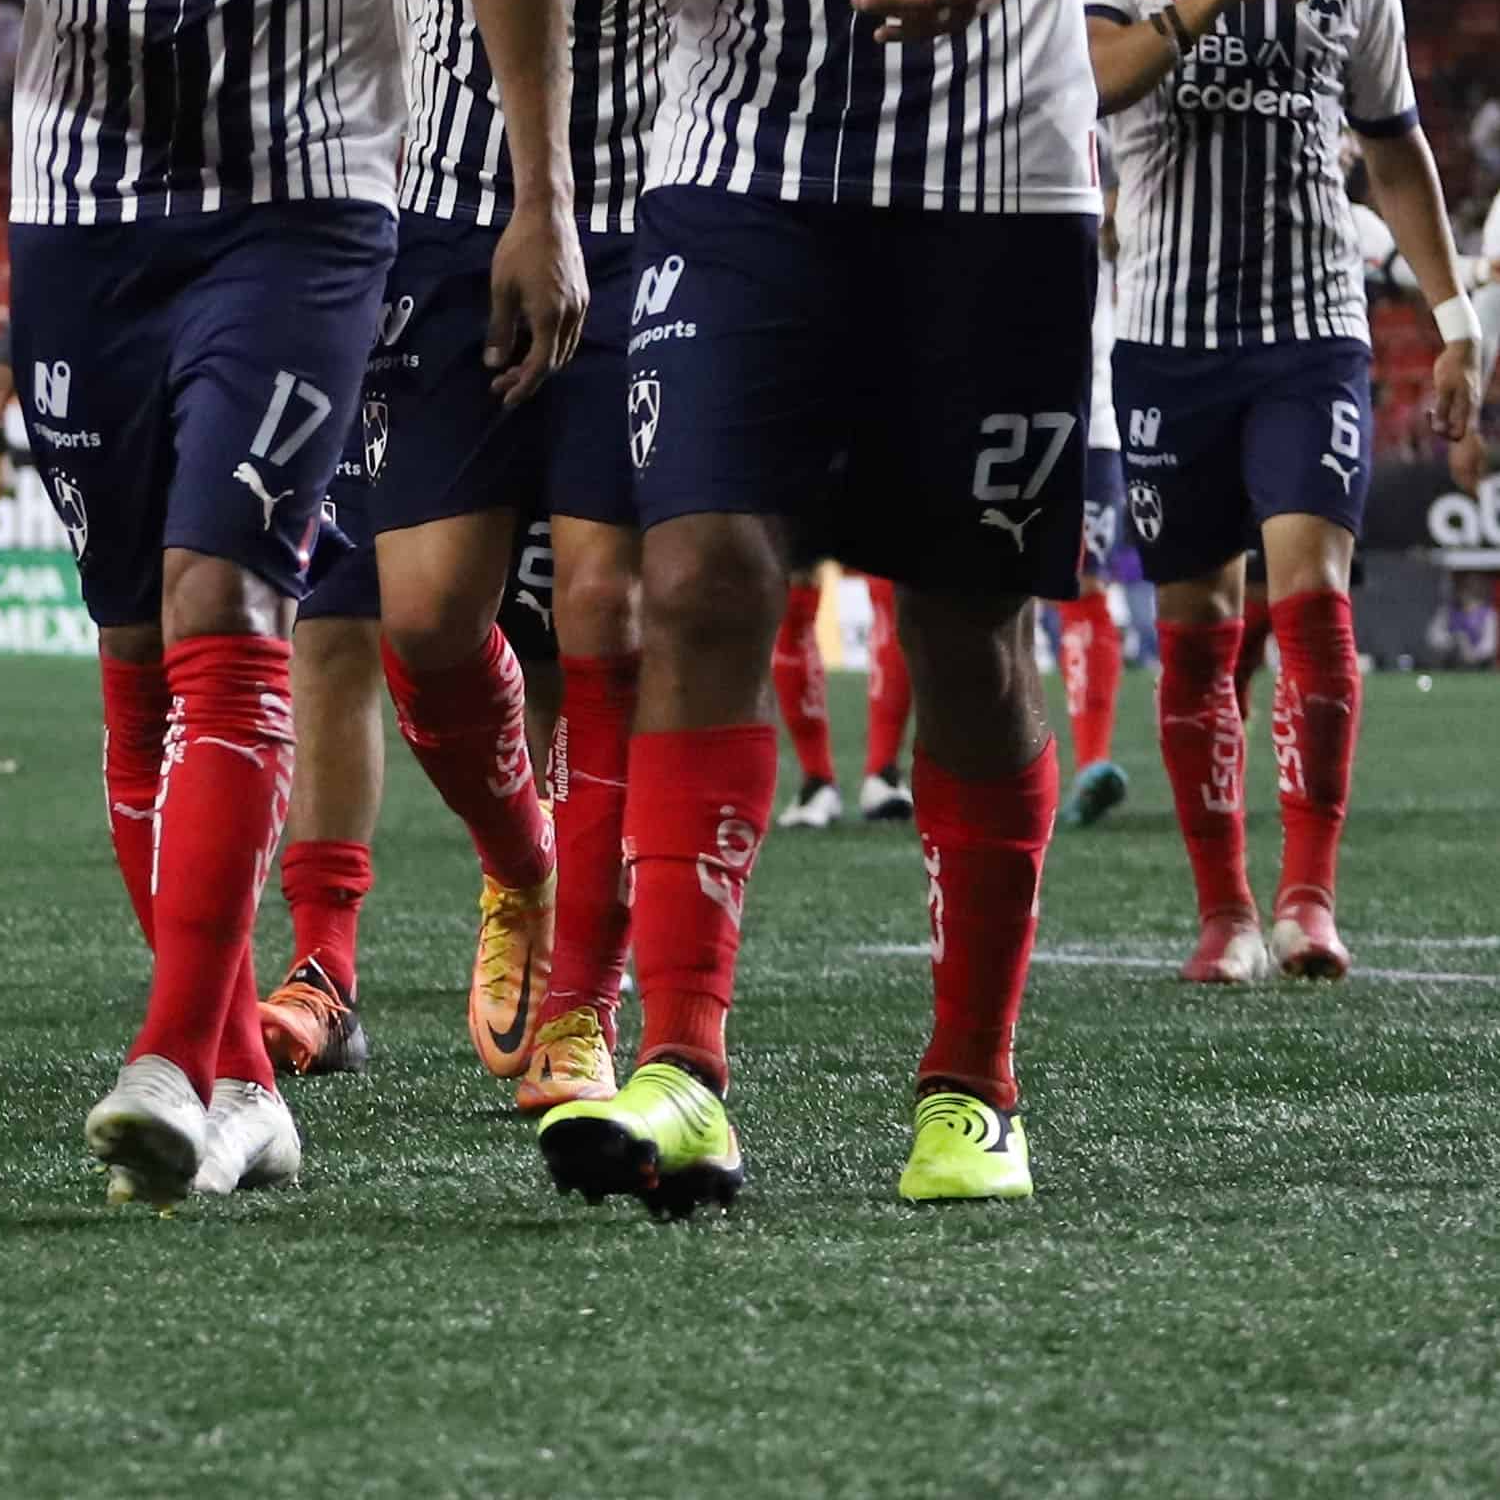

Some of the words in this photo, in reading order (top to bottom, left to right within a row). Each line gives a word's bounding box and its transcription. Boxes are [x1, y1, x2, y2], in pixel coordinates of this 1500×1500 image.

[249, 370, 333, 467] 17
[972, 411, 1077, 501] 27
[1331, 401, 1361, 459] 6
